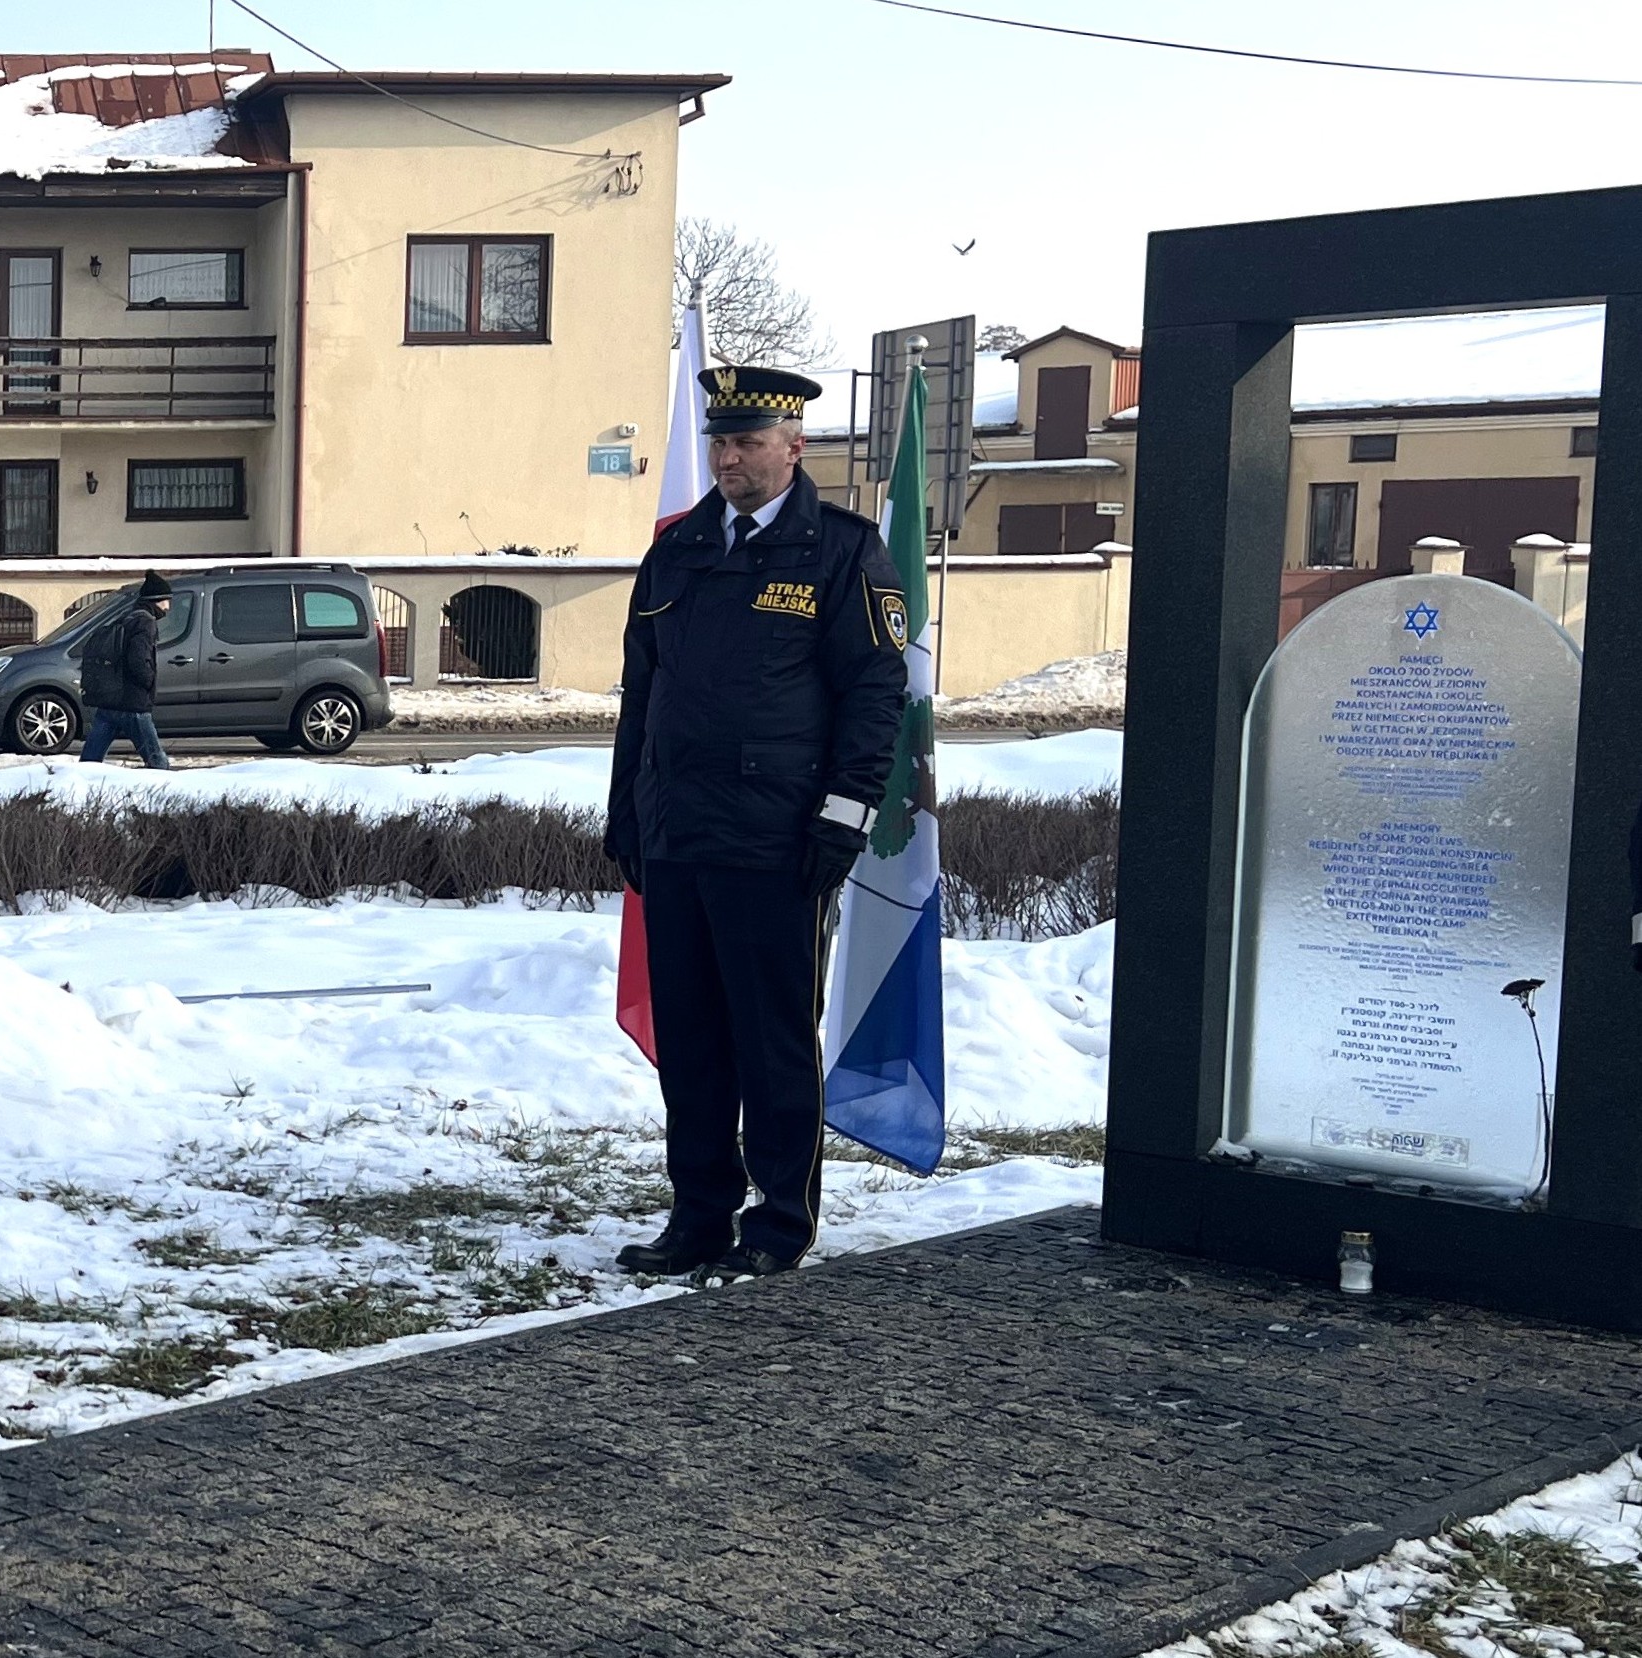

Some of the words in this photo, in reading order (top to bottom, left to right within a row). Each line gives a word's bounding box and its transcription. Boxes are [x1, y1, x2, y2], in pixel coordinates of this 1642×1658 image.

[600, 454, 620, 472] 18
[755, 593, 817, 615] MIEJSKA
[1368, 666, 1407, 676] OKOŁO
[1409, 667, 1431, 677] 700
[1433, 679, 1487, 689] JEZIORNY
[1356, 689, 1433, 700] KONSTANCINA
[1441, 691, 1484, 701] OKOLIC
[1335, 700, 1392, 710] ZMARŁYCH
[1399, 702, 1505, 713] ZAMORDOWANYCH
[1331, 712, 1363, 722] PRZEZ
[1365, 713, 1435, 723] NIEMIECKICH
[1350, 724, 1363, 733] W
[1364, 725, 1413, 735] GETTACH
[1415, 726, 1429, 735] W
[1430, 726, 1484, 737] JEZIORNIE
[1324, 735, 1336, 744] W
[1337, 735, 1400, 746] WARSZAWIE
[1403, 737, 1433, 747] ORAZ
[1435, 739, 1449, 748] W
[1449, 739, 1516, 750] NIEMIECKIM
[1336, 746, 1375, 756] OBOZIE
[1377, 748, 1427, 759] ZAGŁADY
[1430, 750, 1490, 761] TREBLINKA
[1380, 822, 1391, 831] IN
[1393, 823, 1442, 834] MEMORY
[1359, 832, 1374, 841] OF
[1375, 833, 1406, 843] SOME
[1408, 835, 1431, 844] 700
[1309, 840, 1364, 852] RESIDENTS
[1366, 843, 1380, 853] OF
[1331, 853, 1354, 863] AND
[1357, 855, 1374, 865] THE
[1379, 856, 1457, 870] SURROUNDING
[1460, 862, 1489, 872] AREA
[1323, 864, 1349, 874] WHO
[1351, 866, 1375, 876] DIED
[1378, 868, 1402, 878] AND
[1404, 870, 1434, 880] WERE
[1436, 872, 1497, 885] MURDERED
[1335, 876, 1350, 886] BY
[1352, 877, 1371, 887] THE
[1373, 880, 1419, 891] GERMAN
[1421, 883, 1485, 896] OCCUPIERS
[1324, 887, 1335, 896] IN
[1338, 889, 1357, 898] THE
[1360, 890, 1410, 902] JEZIORNA
[1413, 893, 1437, 904] AND
[1439, 896, 1490, 908] WARSAW
[1327, 898, 1376, 910] GHETTOS
[1378, 902, 1401, 913] AND
[1404, 904, 1415, 914] IN
[1418, 905, 1437, 916] THE
[1439, 907, 1488, 920] GERMAN
[1346, 911, 1431, 926] EXTERMINATION
[1433, 918, 1466, 929] CAMP
[1372, 924, 1429, 938] TREBLINKA
[1358, 996, 1387, 1007] יהודים
[1427, 1016, 1456, 1026] תושבי
[1360, 1031, 1399, 1042] הגרמנים
[1410, 1025, 1443, 1036] וסביבה
[1340, 1040, 1374, 1052] ובמחנה
[1400, 1035, 1440, 1047] הכובשים
[1340, 1051, 1384, 1064] טרבלינקה
[1386, 1057, 1418, 1069] הגרמני
[1420, 1061, 1462, 1073] ההשמדה
